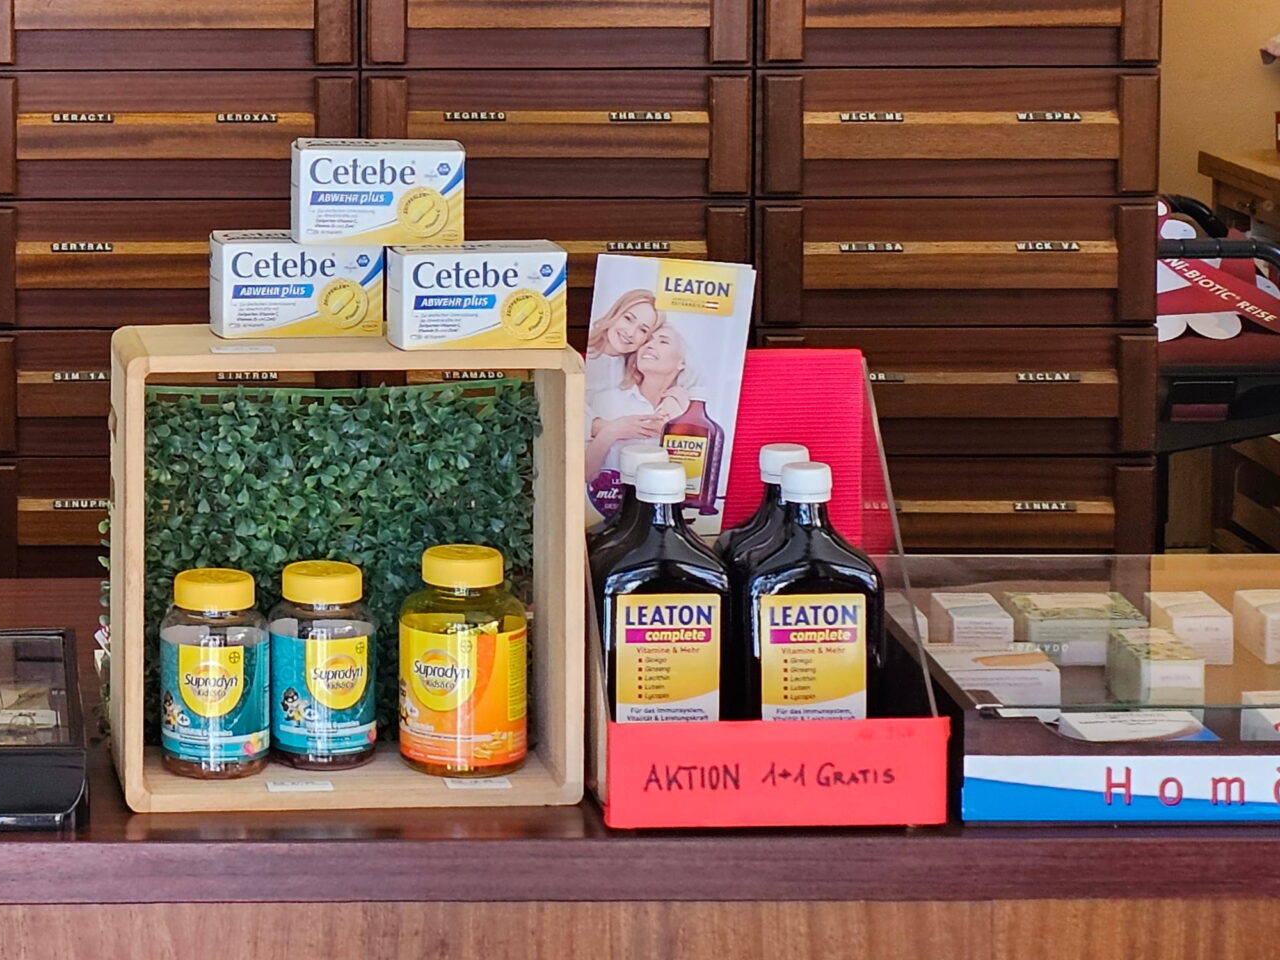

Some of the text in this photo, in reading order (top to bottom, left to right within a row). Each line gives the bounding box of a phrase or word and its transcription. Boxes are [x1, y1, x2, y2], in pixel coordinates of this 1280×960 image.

[445, 112, 505, 120] TEGRETO
[309, 157, 416, 186] Cetebe
[318, 192, 385, 205] ABWEHR plus
[609, 242, 668, 251] TRAJENT
[1016, 241, 1079, 251] WICK VA
[231, 250, 336, 279] Cetebe
[412, 261, 518, 289] Cetebe
[239, 285, 306, 298] ABWEHR plus
[665, 277, 730, 298] LEATON
[421, 296, 488, 309] ABWEHR plus
[1236, 301, 1278, 322] REISE
[666, 439, 704, 451] LEATON
[625, 605, 712, 626] LEATON
[771, 605, 857, 626] LEATON
[645, 630, 706, 642] complete
[790, 630, 851, 642] complete
[313, 666, 364, 681] Supradyn
[413, 661, 471, 679] Supradyn
[184, 674, 238, 688] Supradyn
[644, 762, 895, 792] AKTION 1+1 GRATIS
